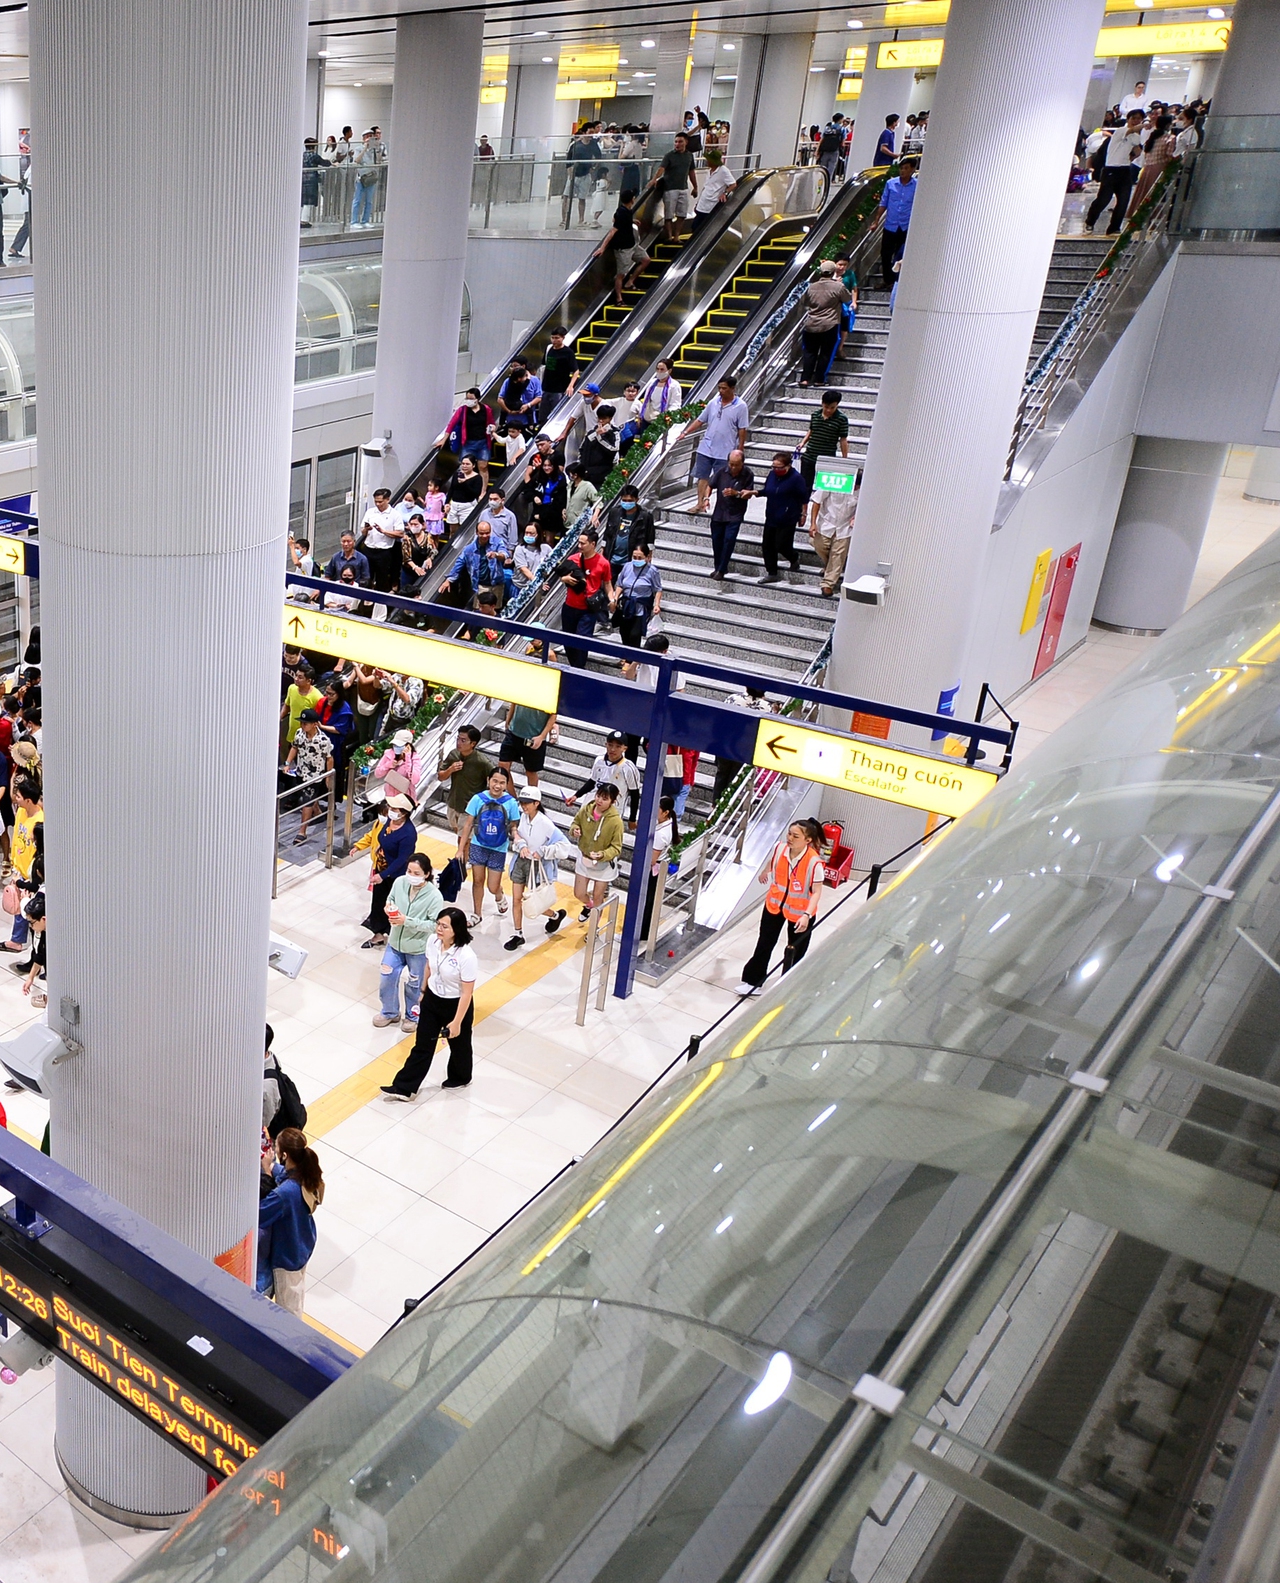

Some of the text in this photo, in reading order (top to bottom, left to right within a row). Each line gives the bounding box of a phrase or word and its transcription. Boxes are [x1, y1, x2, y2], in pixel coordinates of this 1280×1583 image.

[821, 474, 848, 486] EXIT
[335, 627, 348, 638] ra
[844, 769, 907, 795] Escalator
[850, 749, 963, 792] Thang cuốn
[53, 1296, 102, 1346] Suoi
[106, 1334, 158, 1388] Tien
[56, 1327, 238, 1478] Train delayed fo
